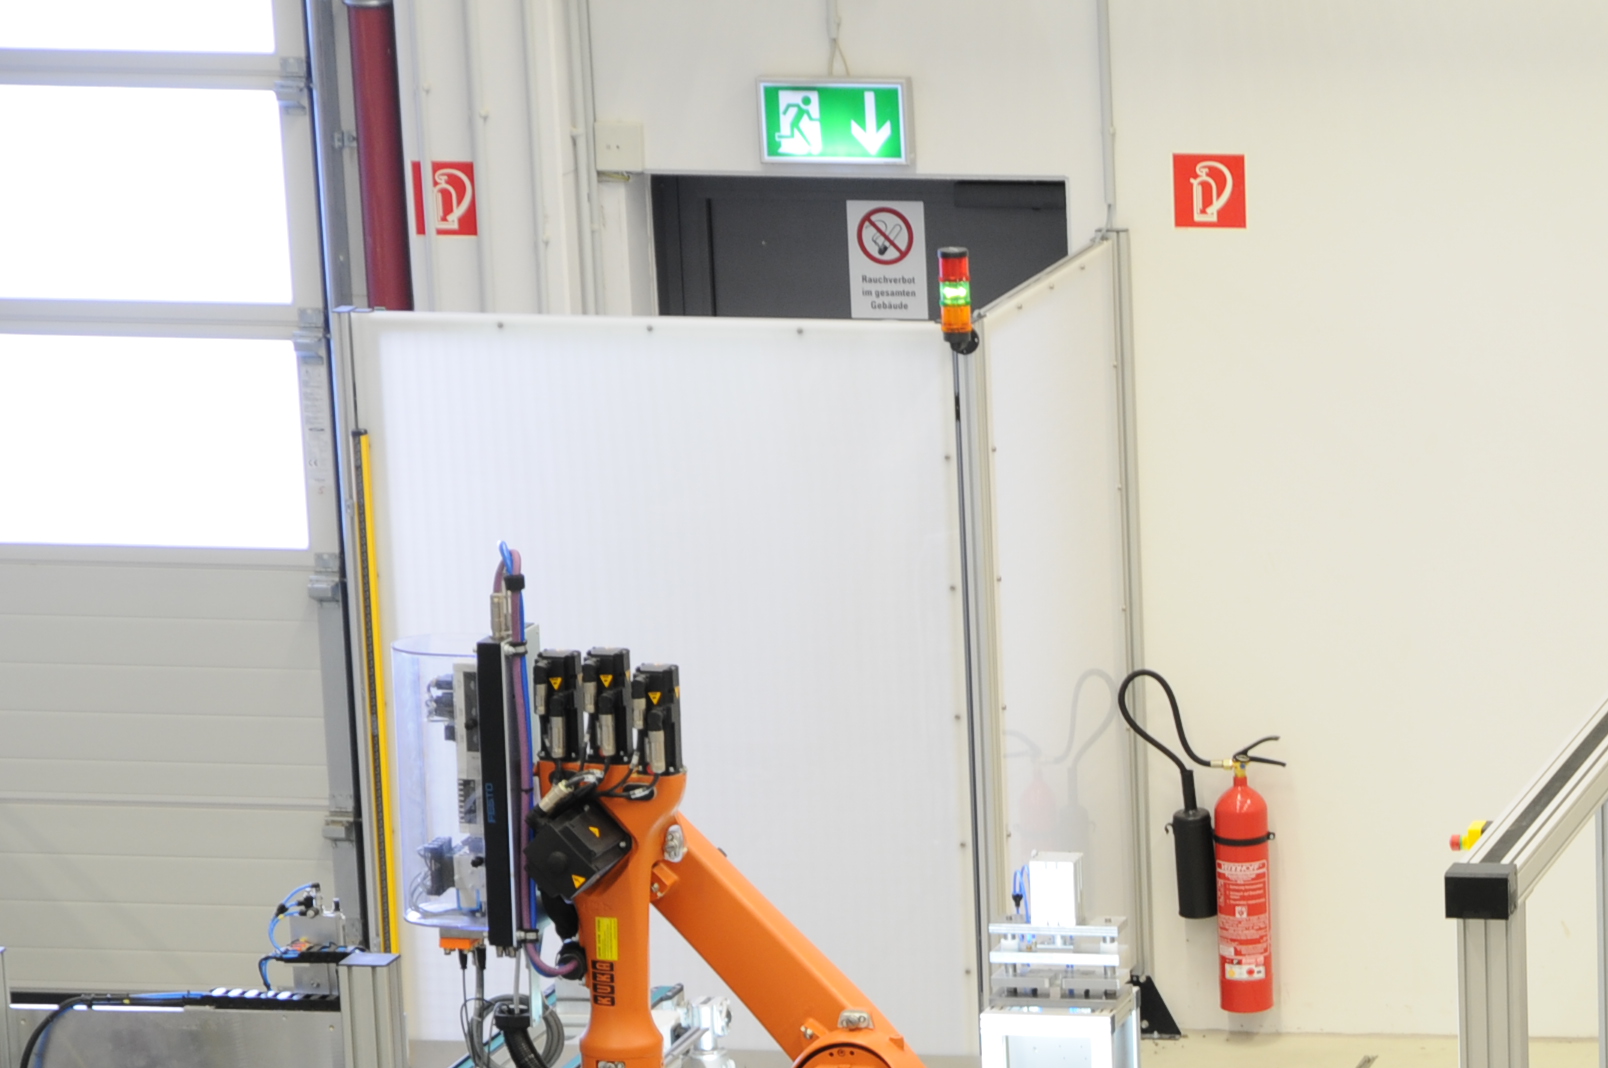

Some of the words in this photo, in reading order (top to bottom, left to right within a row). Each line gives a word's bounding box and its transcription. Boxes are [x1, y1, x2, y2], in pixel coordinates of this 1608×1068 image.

[861, 274, 916, 285] Rauchverbot
[861, 288, 873, 297] im
[874, 288, 917, 299] gesamten
[870, 300, 909, 310] Gebäude
[484, 782, 497, 824] FESTO
[592, 960, 616, 1006] KUKA
